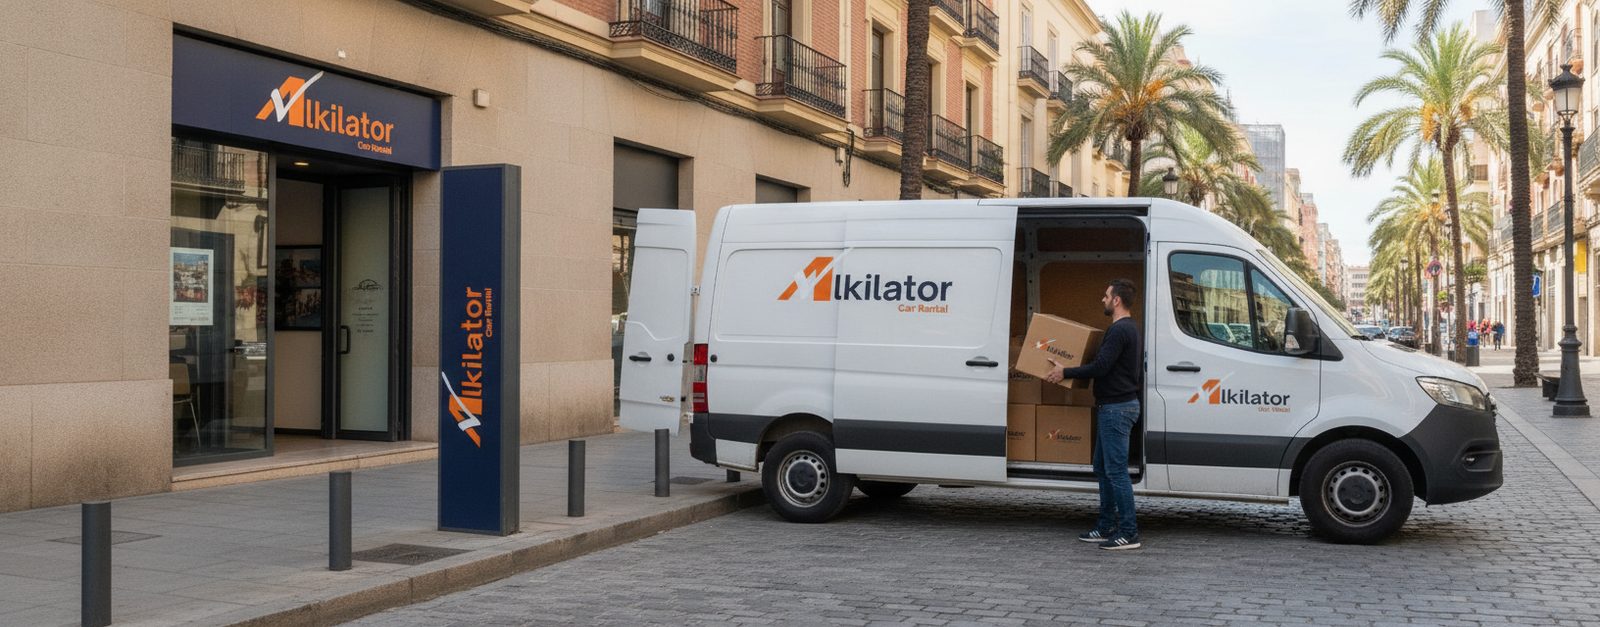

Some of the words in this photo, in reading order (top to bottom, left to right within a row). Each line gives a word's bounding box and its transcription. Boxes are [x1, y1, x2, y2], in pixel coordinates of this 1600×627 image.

[256, 72, 394, 143] Alkilator
[777, 256, 953, 302] Alkilator
[898, 304, 916, 313] Car
[448, 287, 484, 448] Alkilator
[1187, 378, 1291, 406] Alkilator
